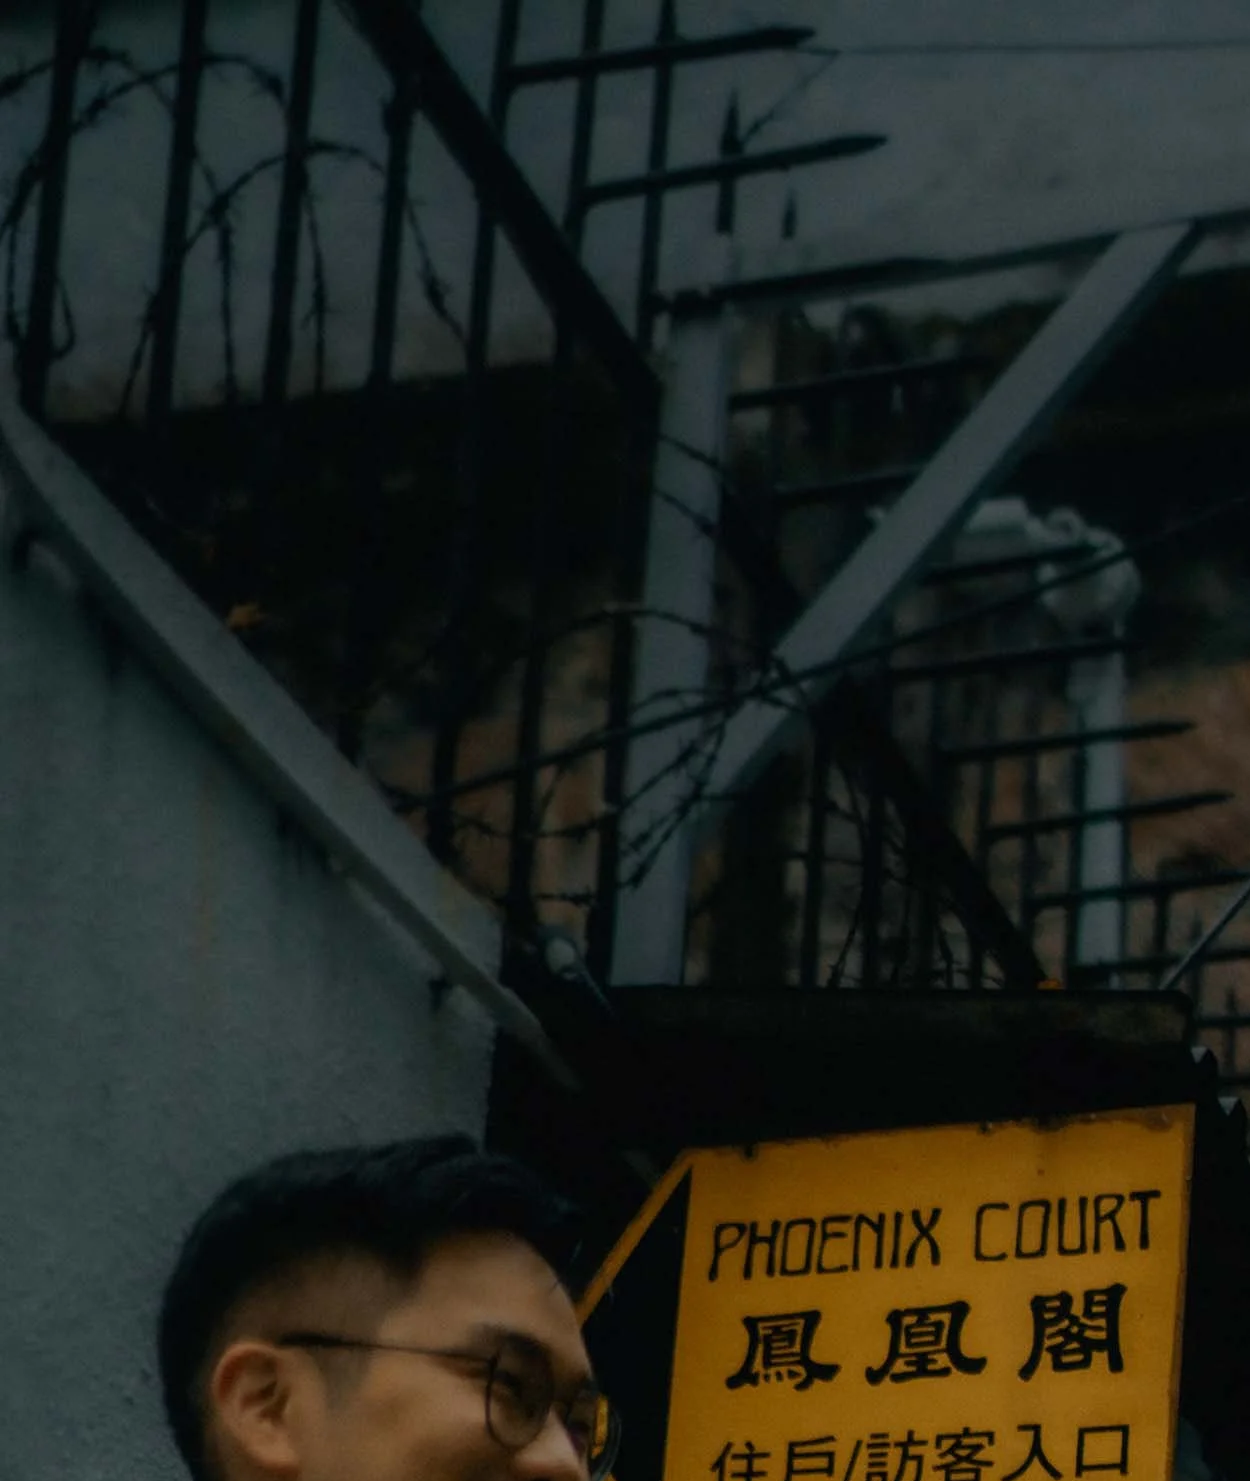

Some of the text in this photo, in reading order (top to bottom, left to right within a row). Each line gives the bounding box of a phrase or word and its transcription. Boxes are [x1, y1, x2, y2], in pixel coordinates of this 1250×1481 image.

[708, 1189, 1162, 1282] PHOENIX COURT
[725, 1282, 1128, 1391] 鳳凰閣
